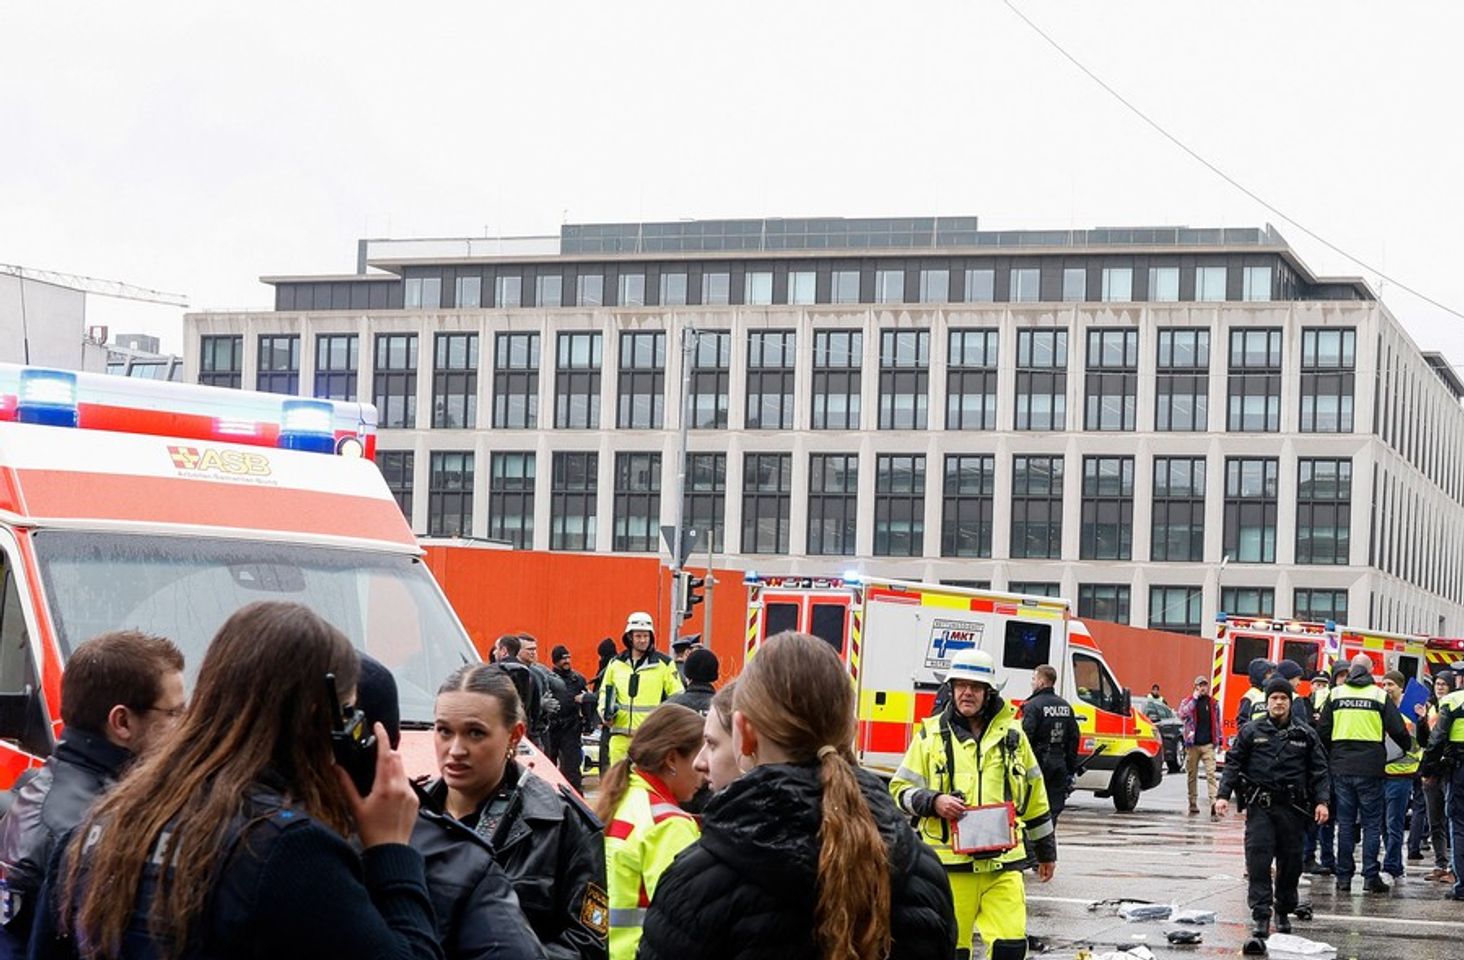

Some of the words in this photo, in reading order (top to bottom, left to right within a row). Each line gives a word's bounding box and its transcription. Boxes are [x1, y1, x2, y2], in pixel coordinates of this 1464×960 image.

[198, 448, 272, 476] ASB
[950, 631, 975, 641] MKT
[1339, 700, 1372, 708] POLIZEI
[1043, 706, 1071, 717] POLIZEI
